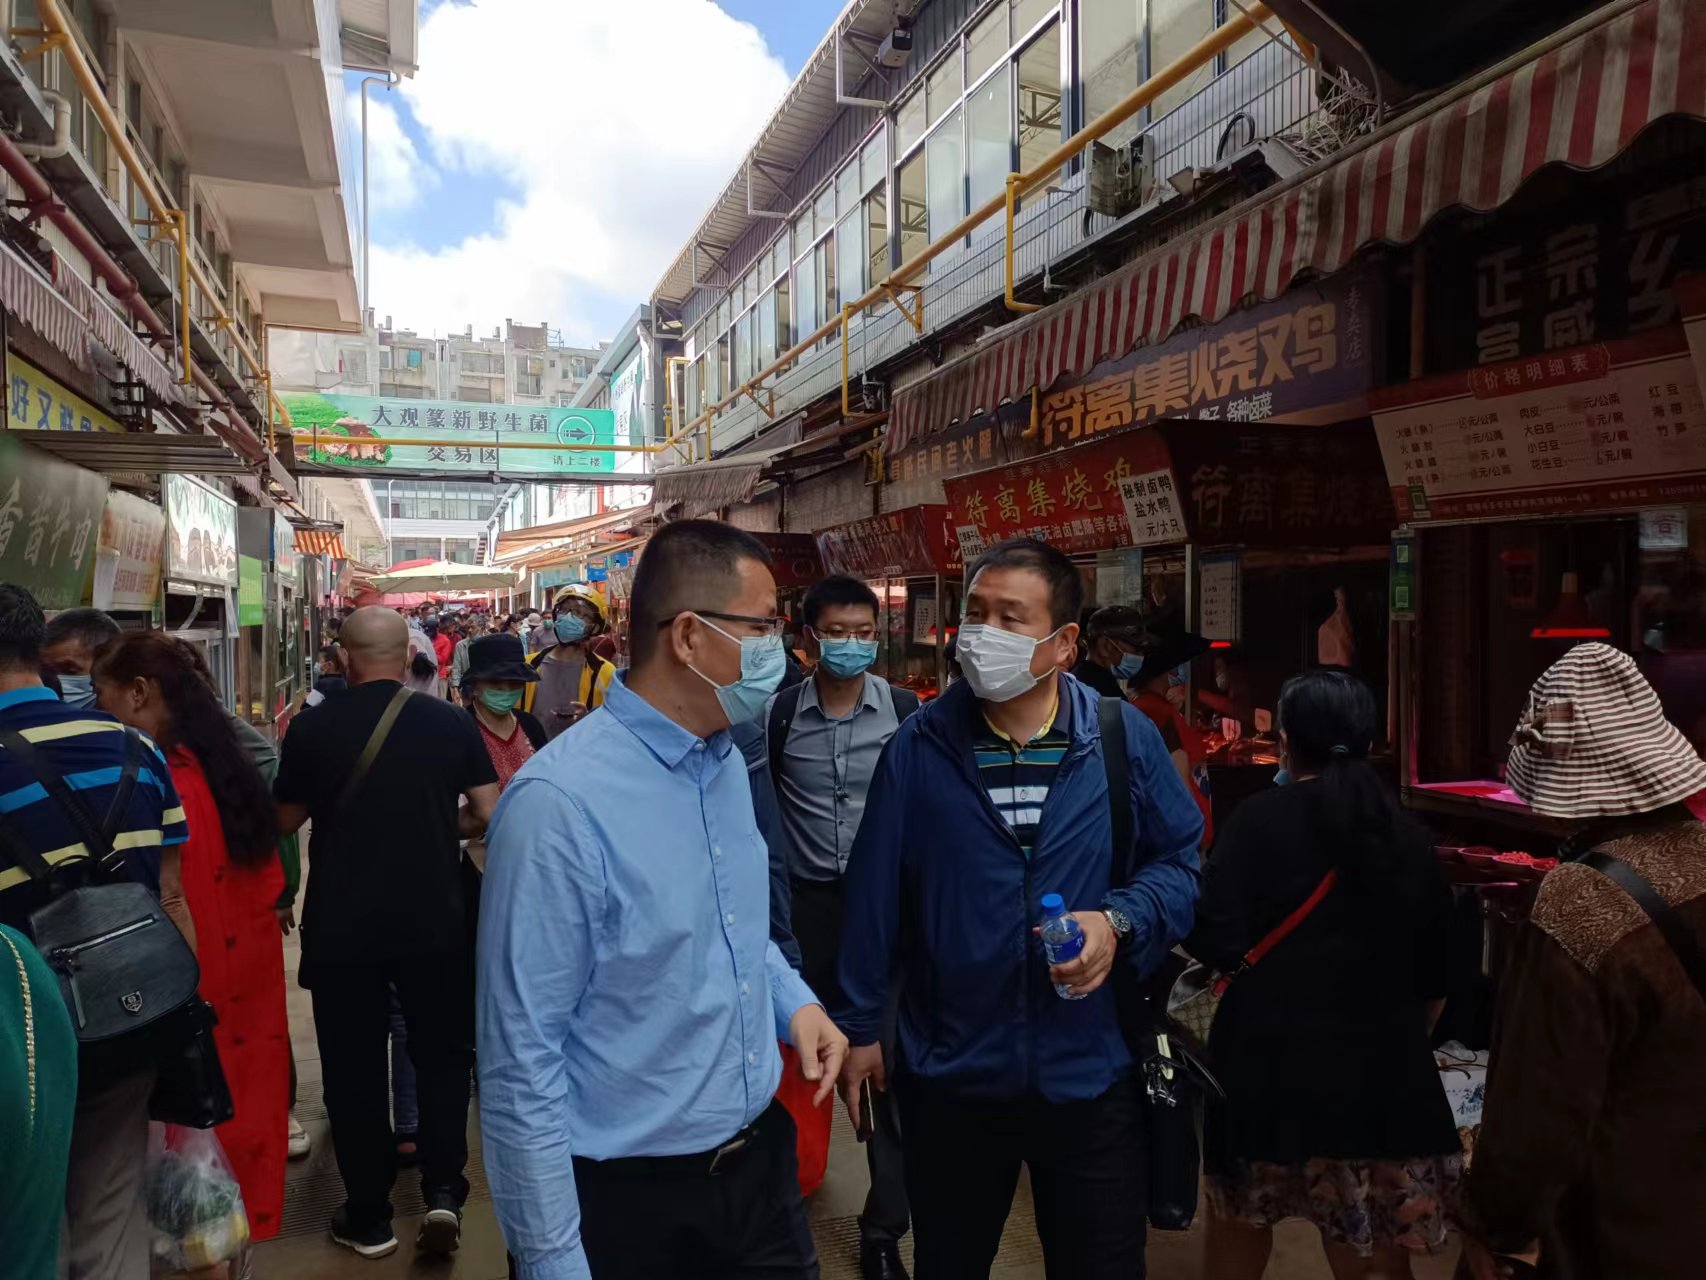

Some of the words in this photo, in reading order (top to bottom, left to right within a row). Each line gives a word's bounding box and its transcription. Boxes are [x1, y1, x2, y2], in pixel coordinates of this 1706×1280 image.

[1042, 303, 1338, 445] 符离集烧鸡
[1484, 353, 1590, 391] 价格明细表
[371, 405, 549, 433] 大观篆新野生菌
[1523, 422, 1556, 437] 大白豆
[427, 446, 499, 465] 交易区
[1527, 439, 1561, 454] 小白豆
[553, 454, 601, 467] 请上二楼
[964, 456, 1132, 529] 符离集烧鸡
[1121, 474, 1172, 500] 秘制卤鸭
[1133, 496, 1171, 518] 盐水鸭
[1146, 518, 1181, 537] 元/大只
